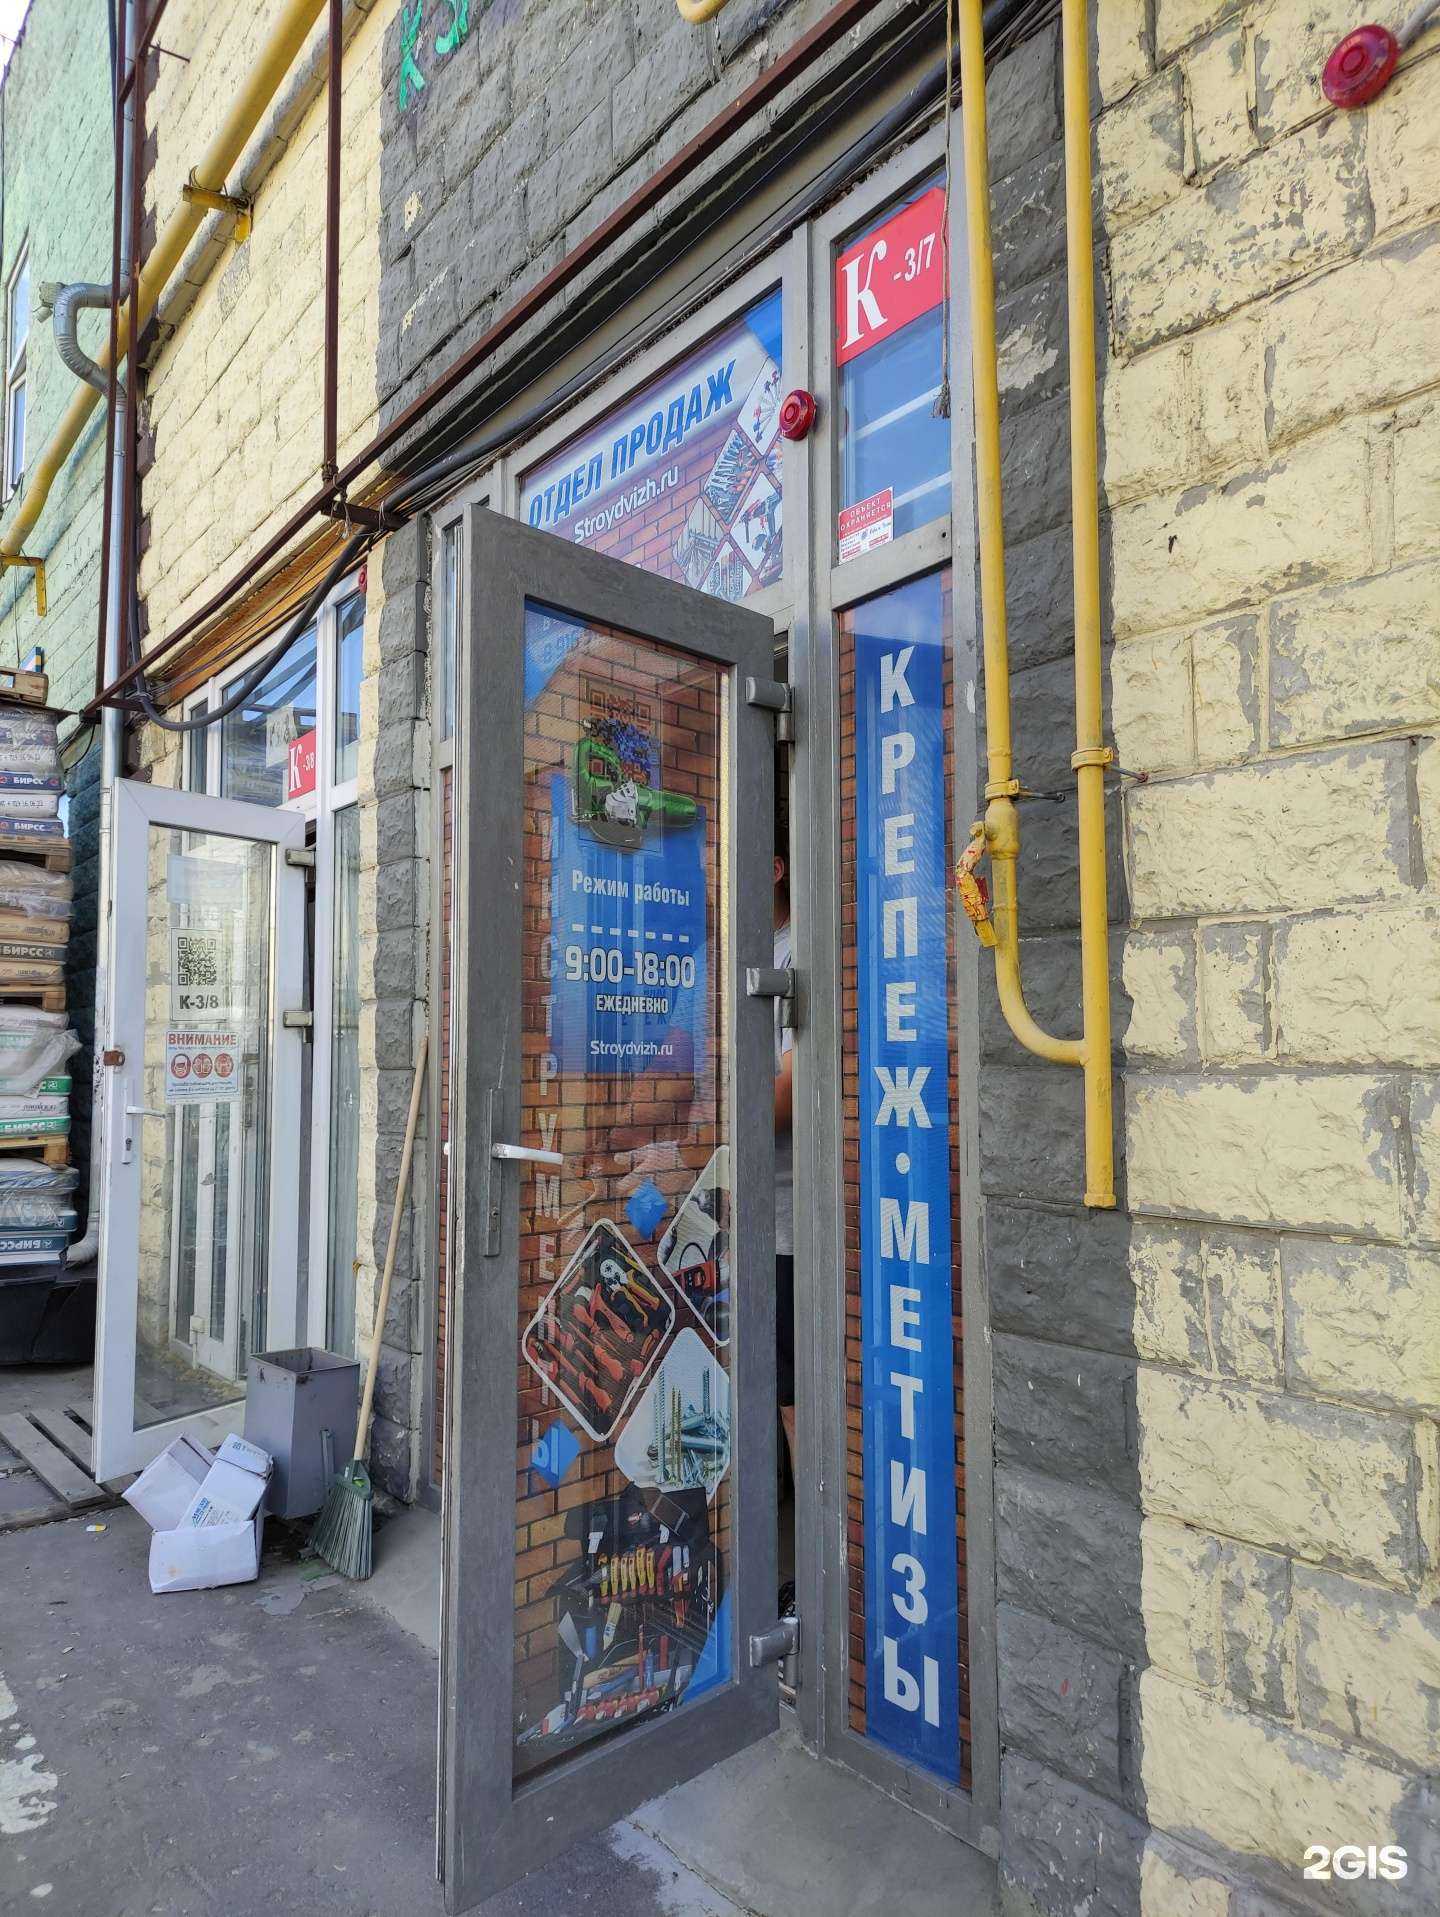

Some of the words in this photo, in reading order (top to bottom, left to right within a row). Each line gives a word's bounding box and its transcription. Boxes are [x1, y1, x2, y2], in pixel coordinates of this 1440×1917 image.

[528, 451, 604, 530] ОТДЕЛ
[610, 358, 737, 481] ПРОДАЖ
[573, 465, 680, 544] Stroydvizh.ru
[13, 776, 44, 785] БИРСС
[14, 822, 46, 831] БИРСС
[572, 869, 629, 899] Режим
[634, 881, 690, 907] работы
[874, 644, 933, 1129] КРЕПЕЖ
[2, 945, 44, 957] БИРСС
[565, 945, 696, 989] 9:00-18:00
[596, 994, 669, 1015] ЕЖЕДНЕВНО
[168, 1033, 237, 1046] ВНИМАНИЕ
[590, 1039, 673, 1059] Stroydvizh.ru
[879, 1196, 940, 1728] МЕТИЗЫ
